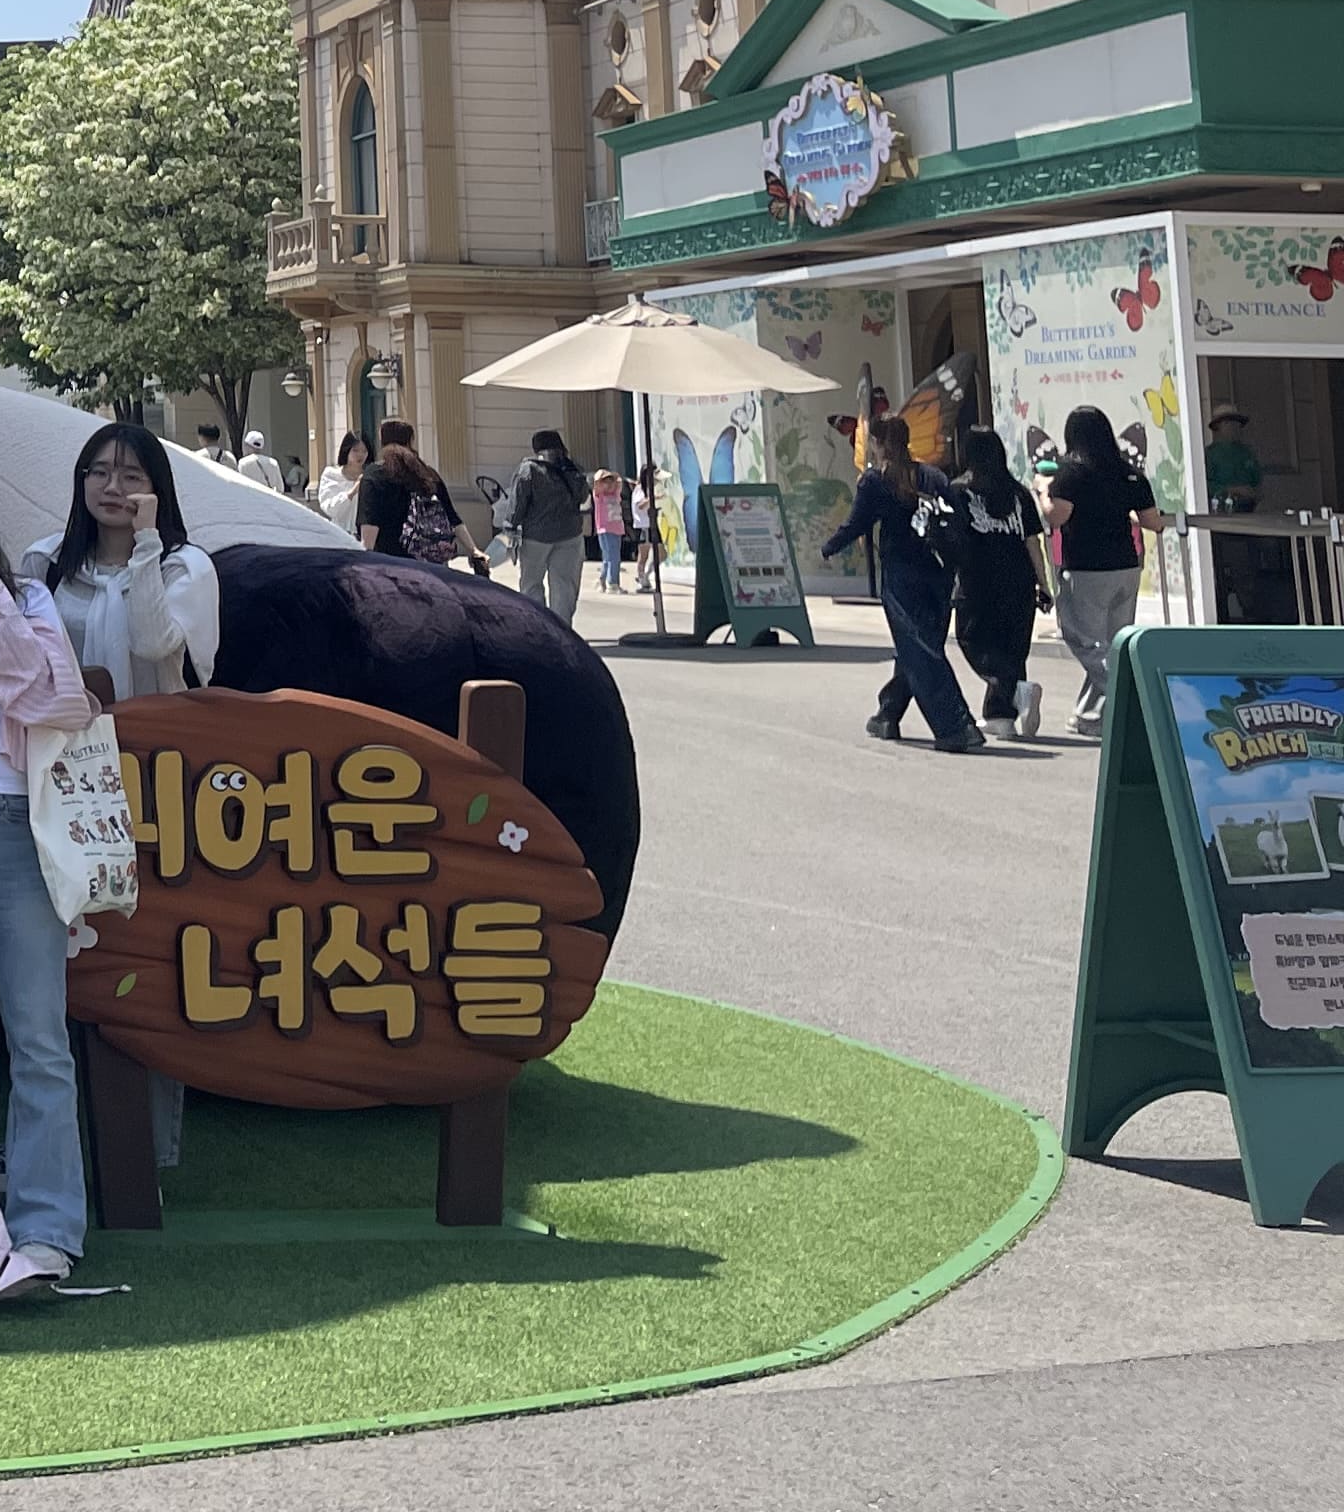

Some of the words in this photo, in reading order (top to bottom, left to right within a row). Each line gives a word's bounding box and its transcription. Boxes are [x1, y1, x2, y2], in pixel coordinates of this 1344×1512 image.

[1227, 301, 1326, 318] ENTRANCE
[1024, 348, 1084, 365] DREAMING
[1088, 344, 1137, 361] GARDEN
[1237, 702, 1338, 729] FRIENDLY
[1212, 730, 1307, 767] RANCH
[181, 900, 552, 1041] 녀석들
